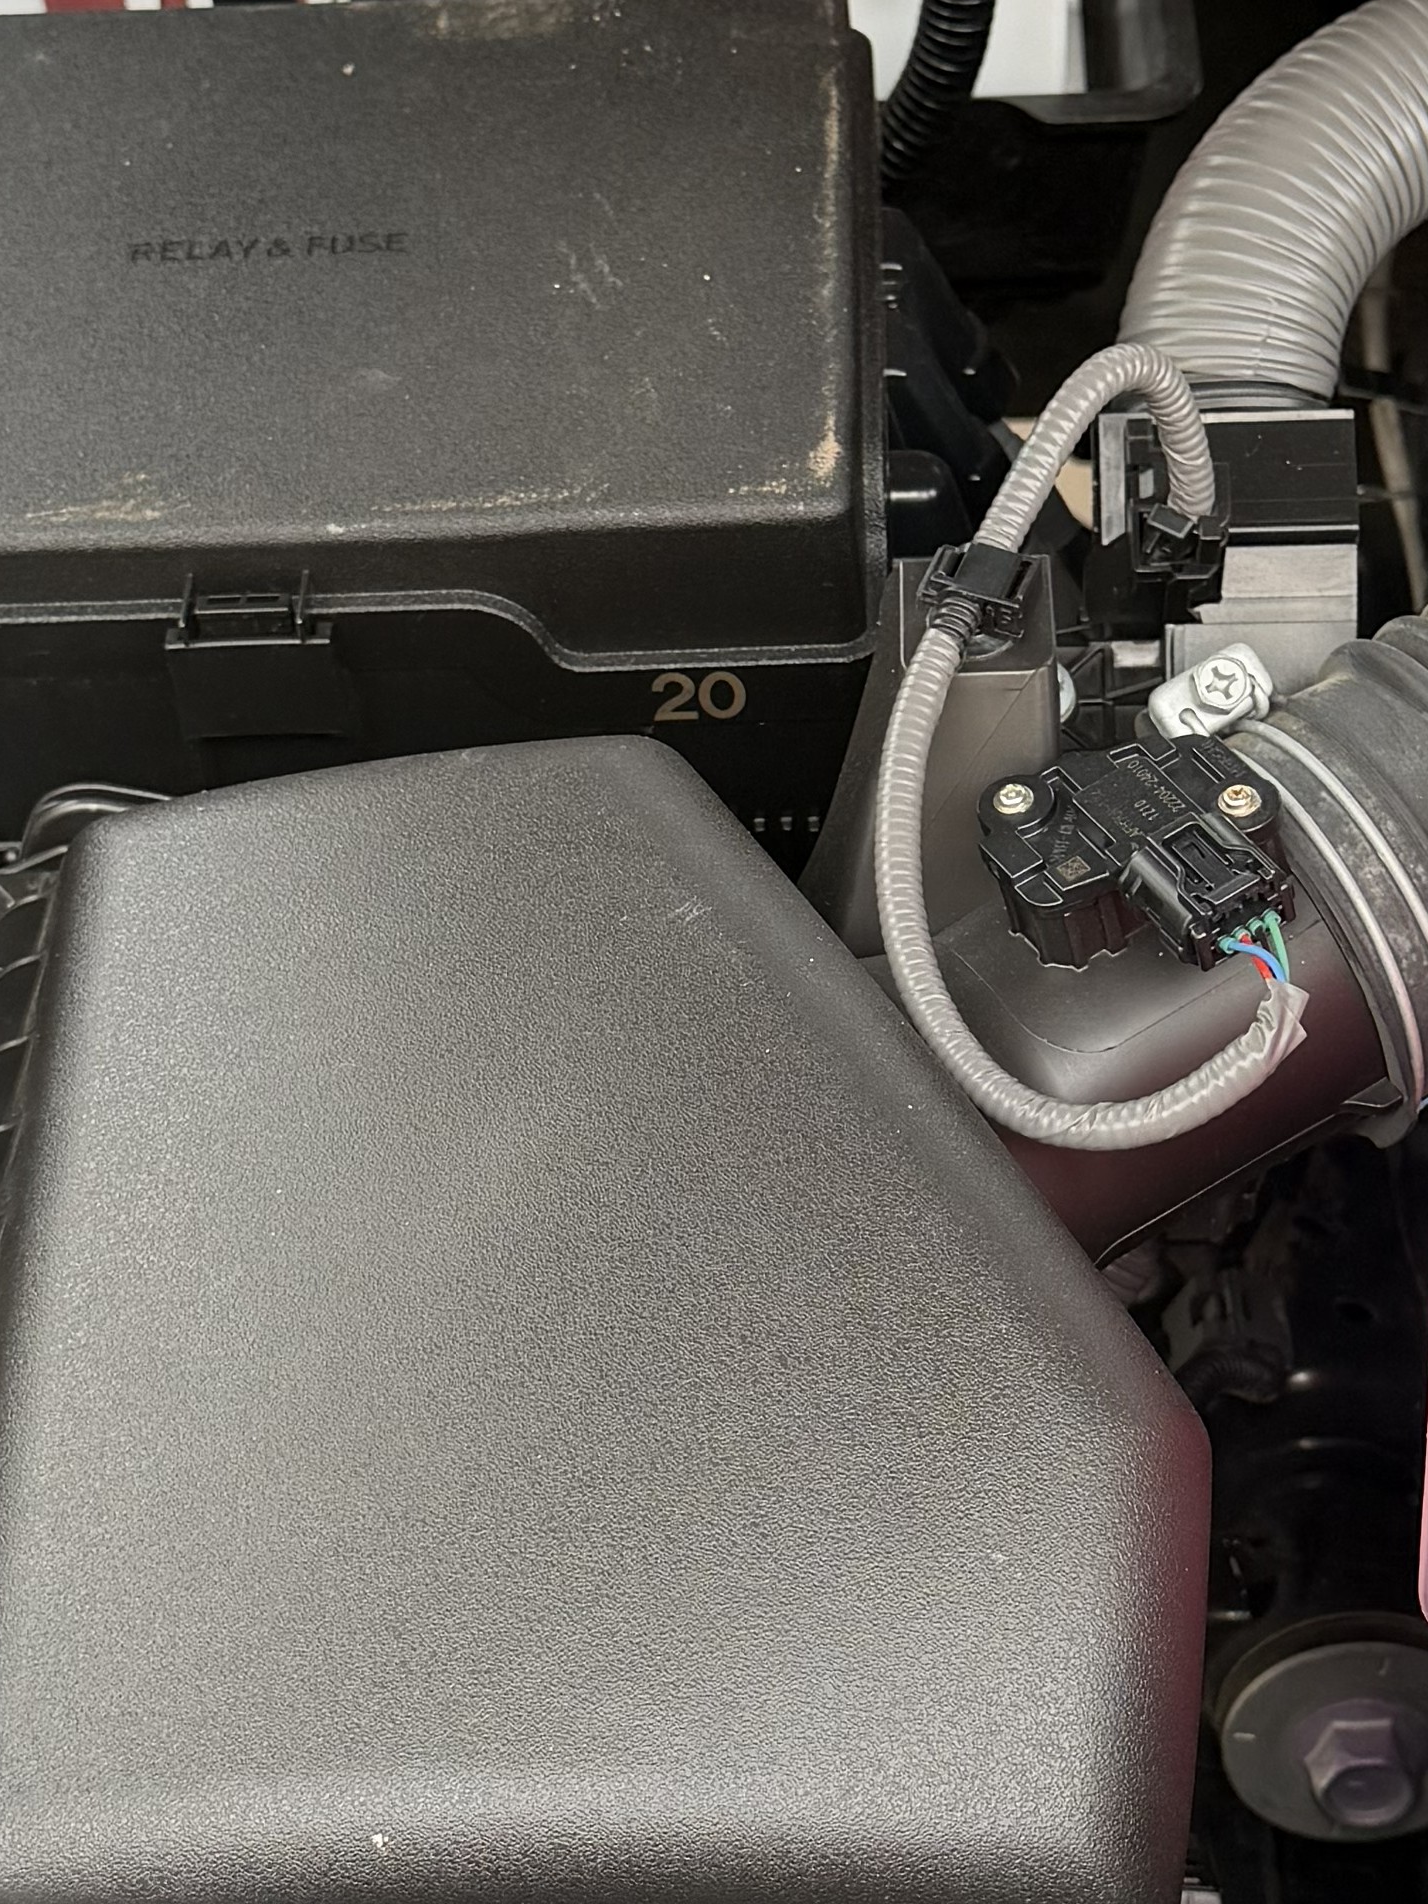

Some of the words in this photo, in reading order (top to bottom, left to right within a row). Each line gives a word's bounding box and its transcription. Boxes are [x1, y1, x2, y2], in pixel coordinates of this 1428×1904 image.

[129, 238, 259, 264] RELAY
[267, 237, 294, 259] &
[305, 232, 410, 257] FUSE
[651, 671, 747, 721] 20
